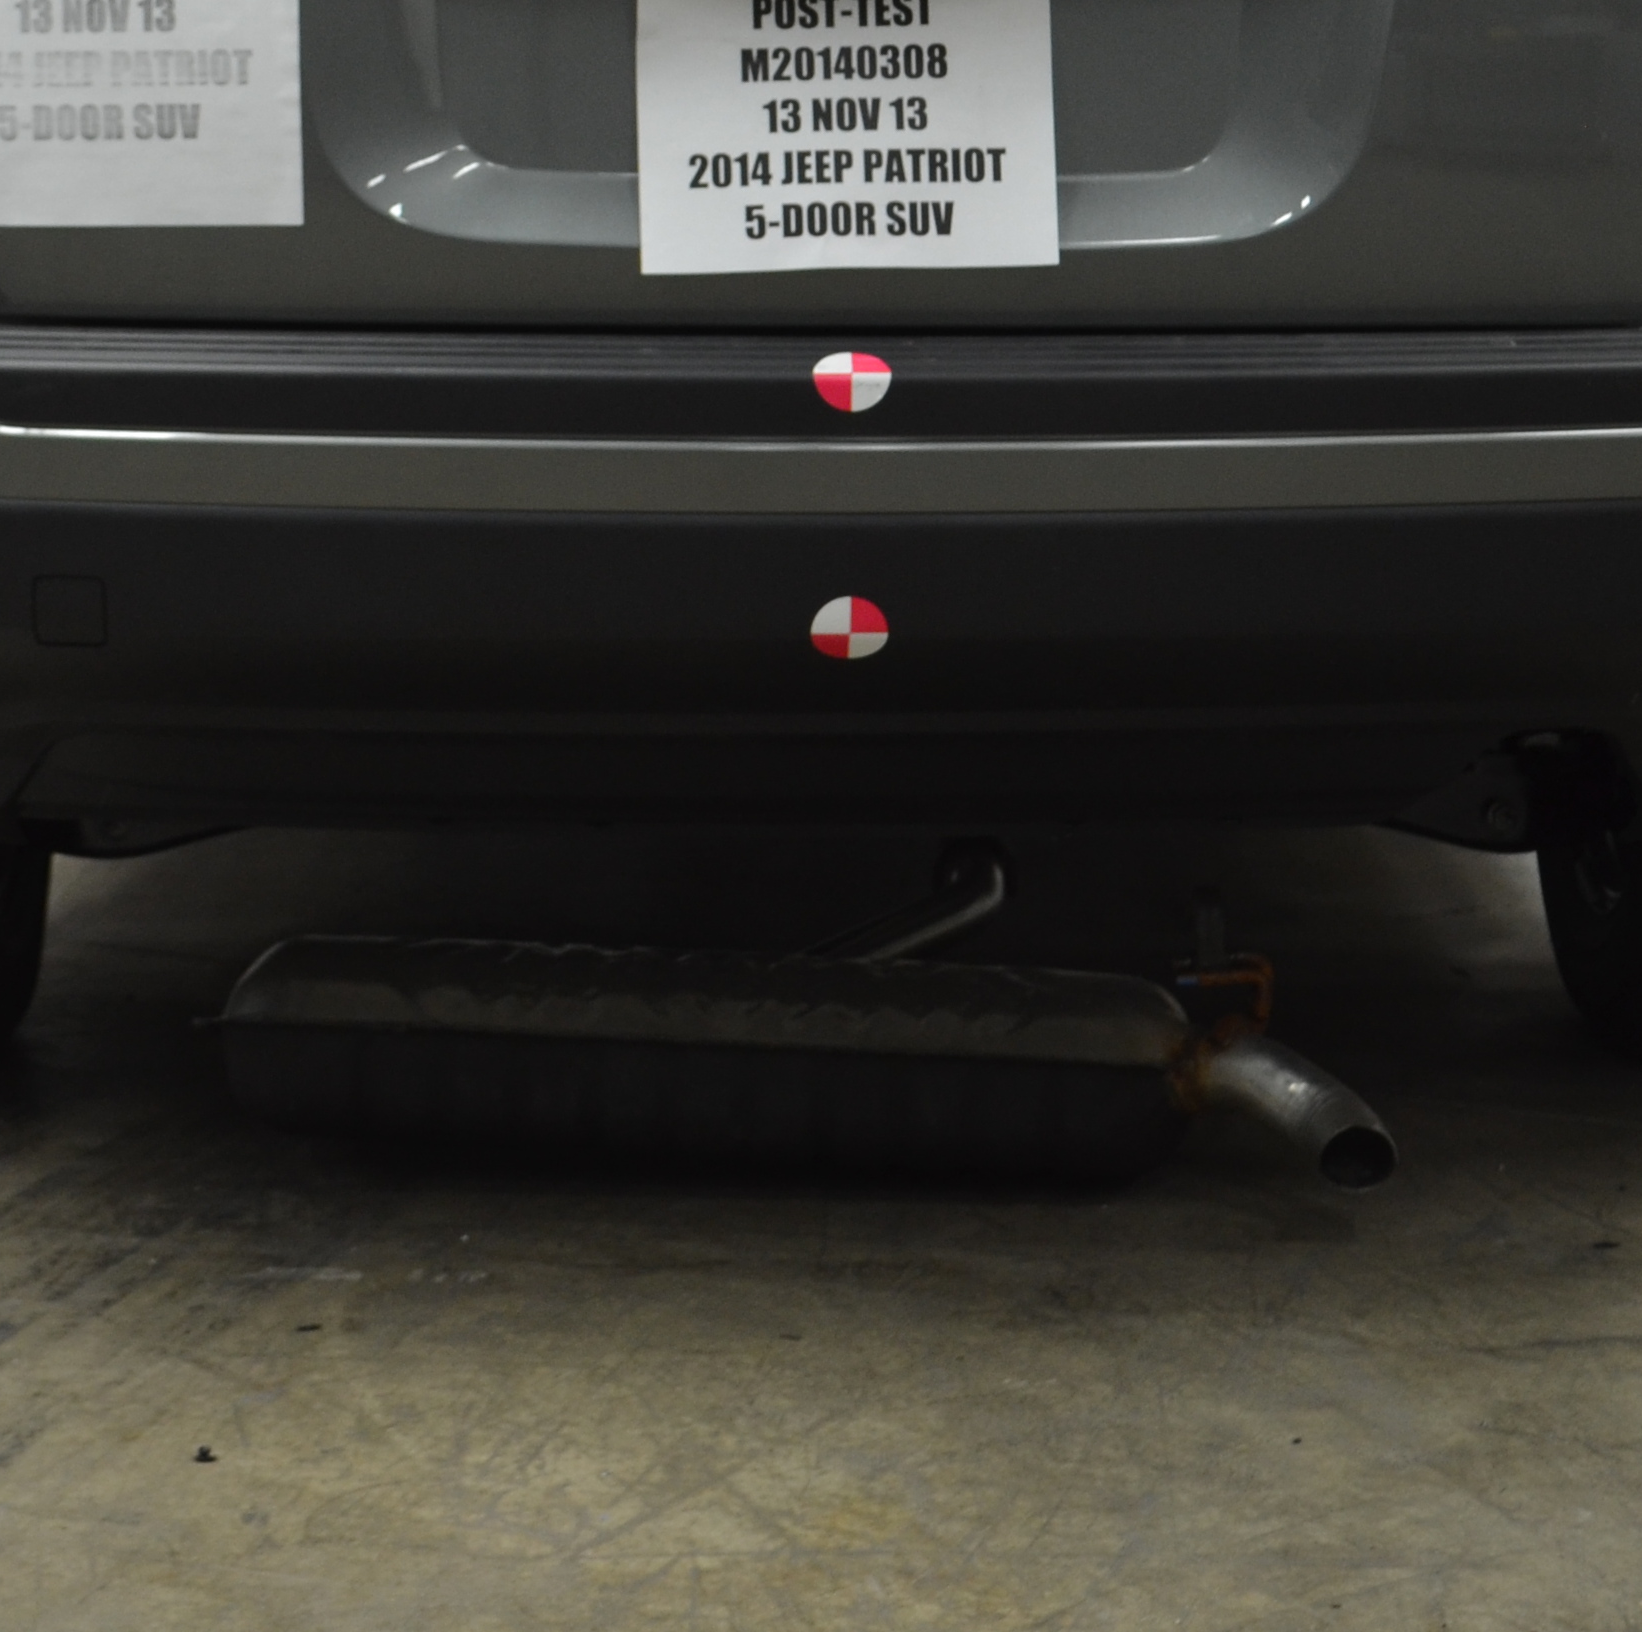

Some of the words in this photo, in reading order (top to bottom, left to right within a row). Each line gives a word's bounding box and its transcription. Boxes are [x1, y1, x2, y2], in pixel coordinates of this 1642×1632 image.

[111, 48, 253, 86] PATRIOT
[741, 43, 948, 82] M20140308
[133, 103, 201, 140] SUV
[763, 98, 802, 133] 13
[811, 98, 881, 132] NOV
[889, 96, 928, 131] 13
[689, 152, 772, 189] 2014
[781, 150, 853, 185] JEEP
[863, 147, 1006, 183] PATRIOT
[745, 202, 876, 239] 5-DOOR
[886, 201, 955, 237] SUV
